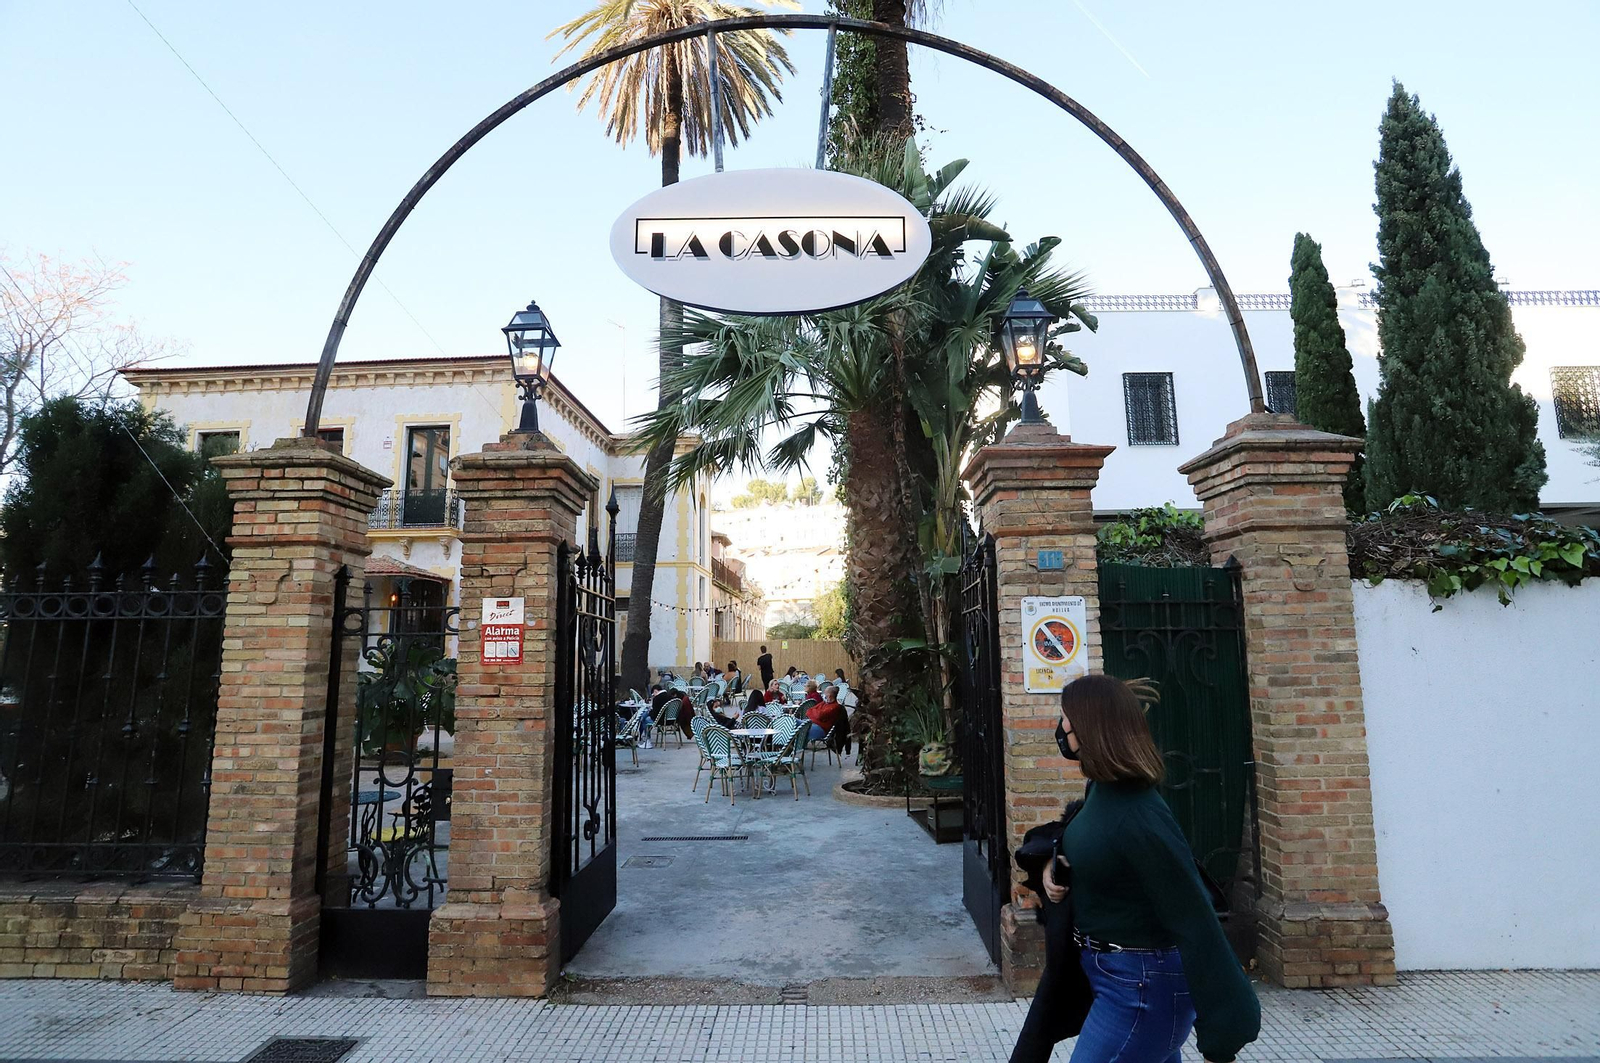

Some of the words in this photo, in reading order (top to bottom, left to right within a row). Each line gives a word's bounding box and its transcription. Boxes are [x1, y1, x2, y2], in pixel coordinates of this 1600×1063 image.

[651, 230, 709, 258] LA
[718, 229, 895, 258] CASONA
[485, 626, 520, 636] Alarma
